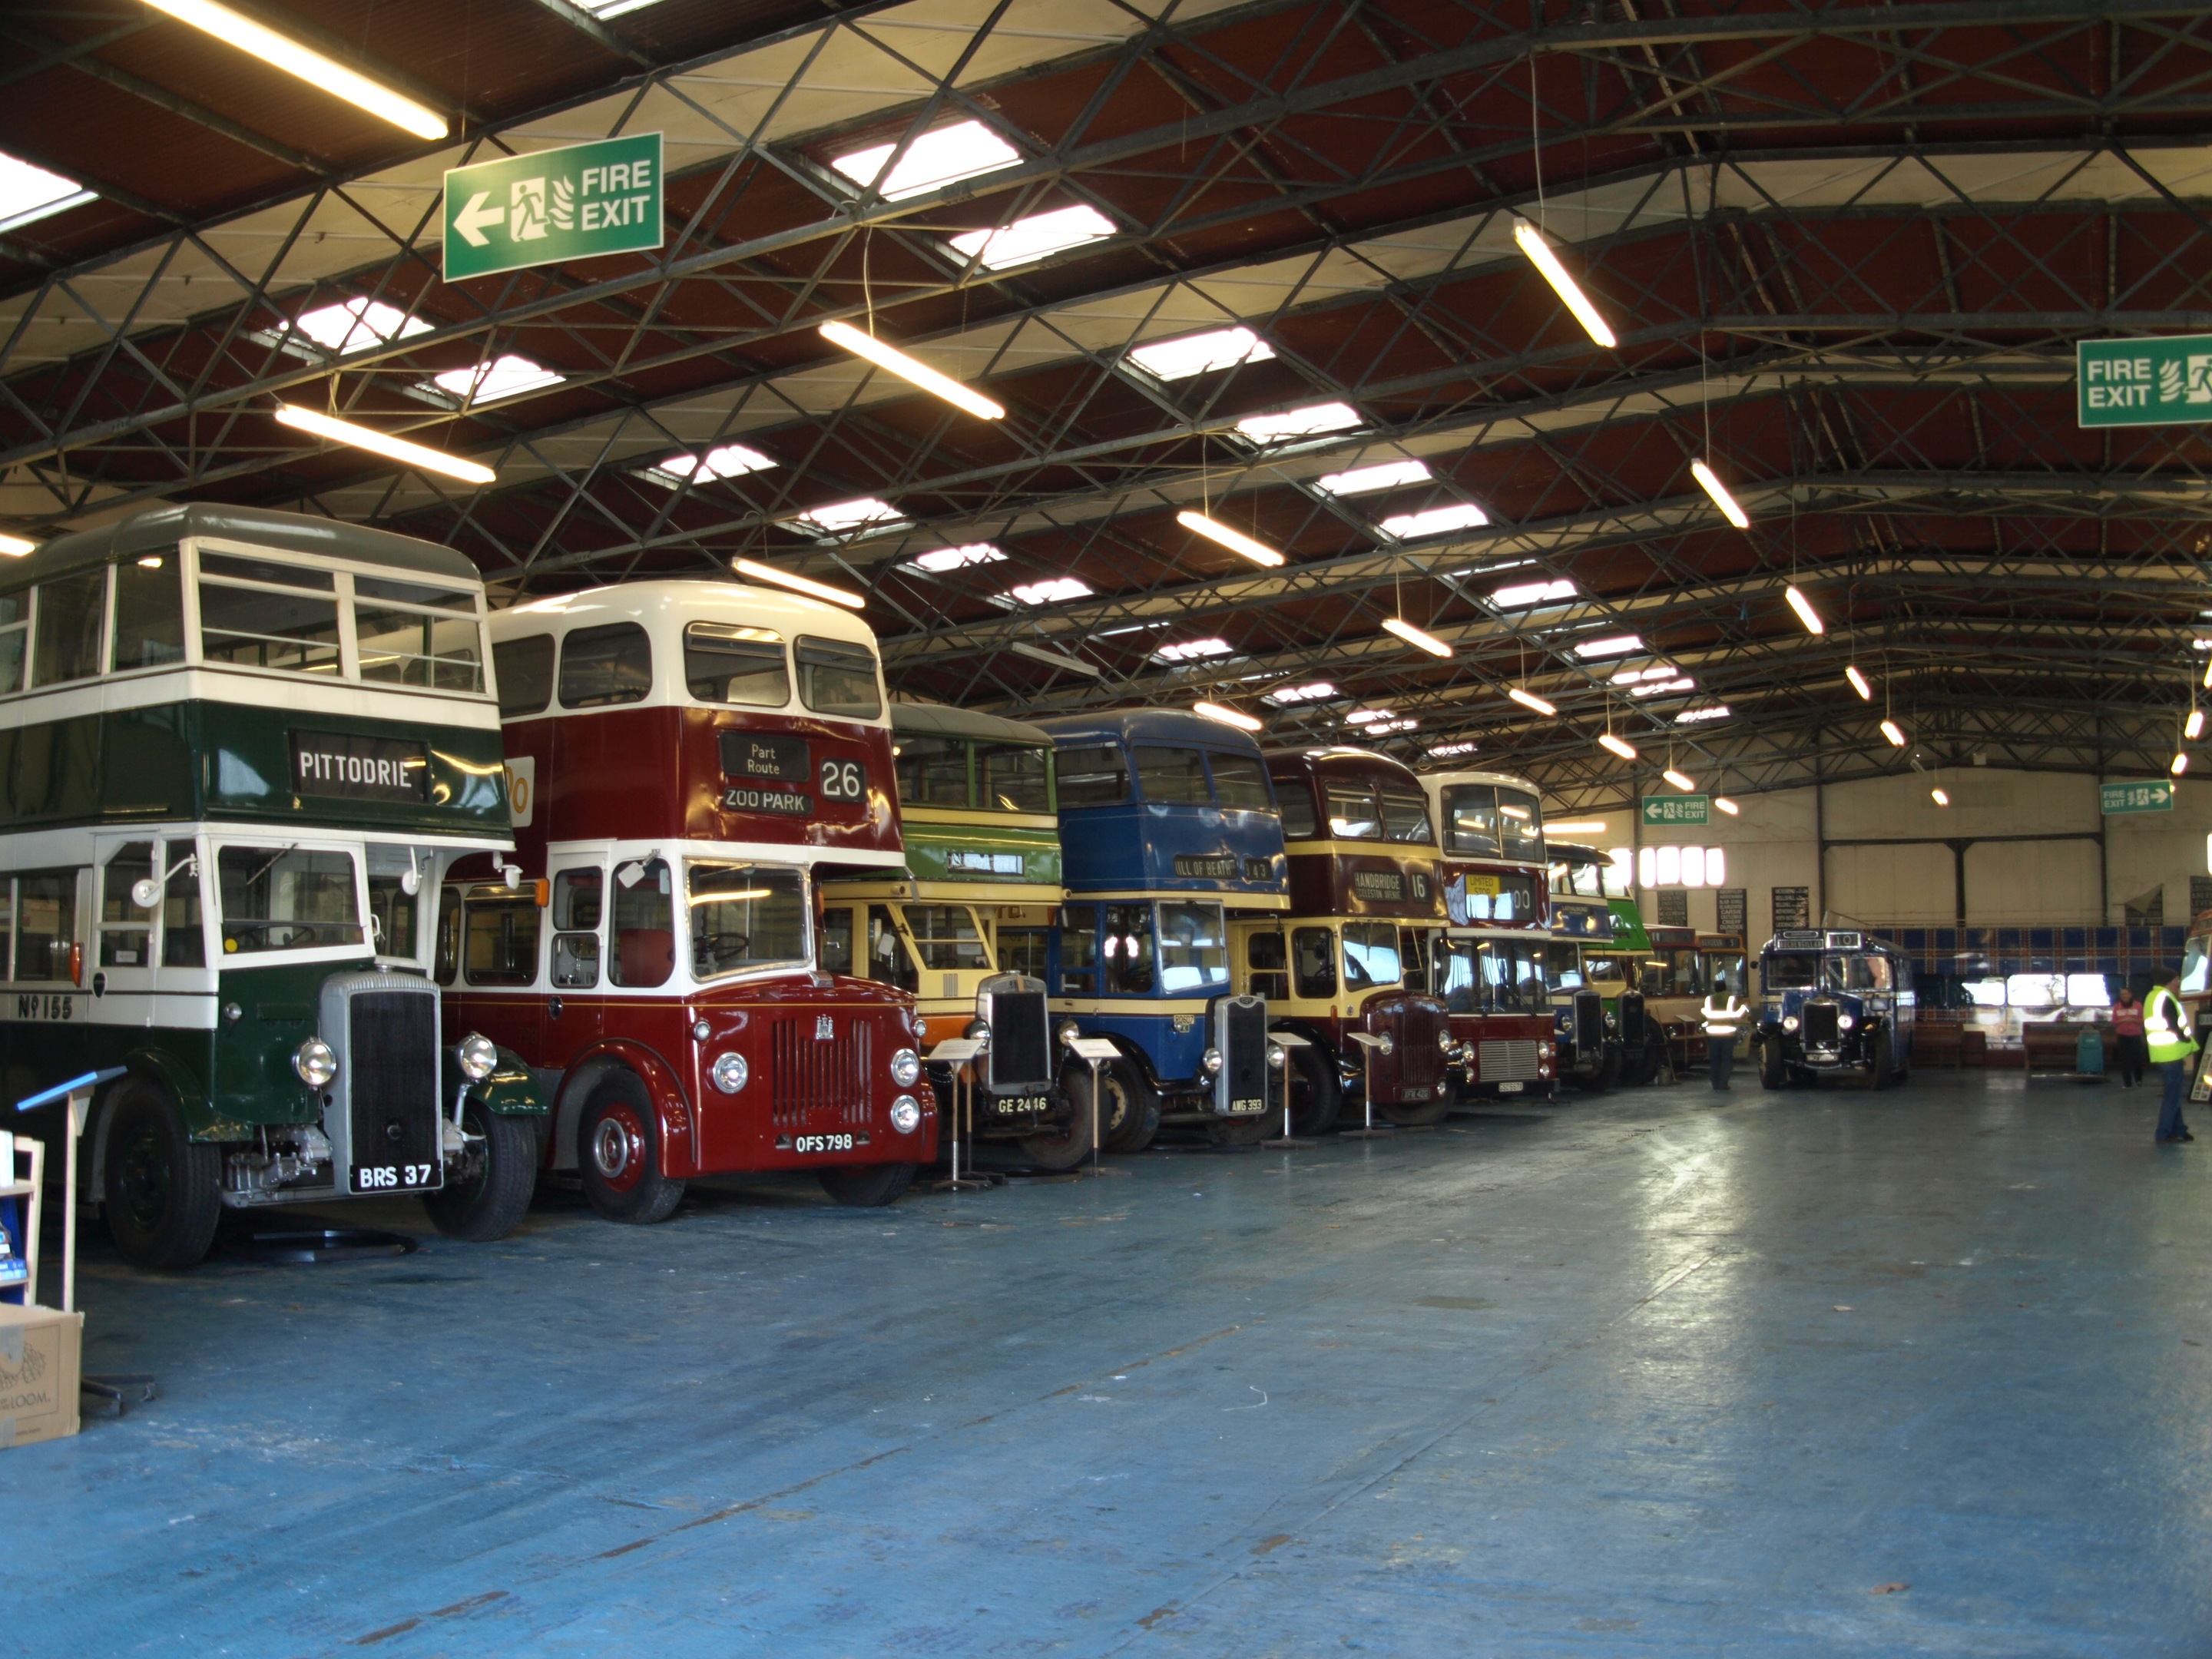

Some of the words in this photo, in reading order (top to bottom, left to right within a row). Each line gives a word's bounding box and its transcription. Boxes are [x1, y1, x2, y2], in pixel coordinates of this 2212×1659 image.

[582, 160, 651, 197] FIRE
[581, 195, 651, 231] EXIT
[2088, 358, 2151, 382] FIRE
[2088, 385, 2151, 408] EXIT
[751, 743, 777, 760] Part
[300, 751, 412, 788] PITTODRIE
[747, 758, 780, 775] Route
[822, 761, 861, 797] 26
[726, 789, 759, 807] ZOO
[763, 792, 805, 811] PARK
[2103, 790, 2126, 799] FIRE
[2104, 799, 2126, 808] EXIT
[1684, 801, 1706, 810] FIRE
[1684, 810, 1706, 819] EXIT
[1193, 862, 1203, 876] OF
[1206, 861, 1232, 876] BEATH
[1354, 872, 1401, 890] HANDBRIDGE
[1412, 874, 1426, 898] 16
[1469, 876, 1494, 887] LIMITED
[44, 996, 72, 1019] 155
[998, 1098, 1014, 1113] GE
[1232, 1100, 1247, 1111] AWG
[1247, 1098, 1262, 1111] 393
[796, 1136, 824, 1152] OFS
[826, 1134, 853, 1151] 798
[359, 1166, 398, 1187] BRS
[405, 1164, 432, 1184] 37
[11, 1392, 46, 1407] LOOM
